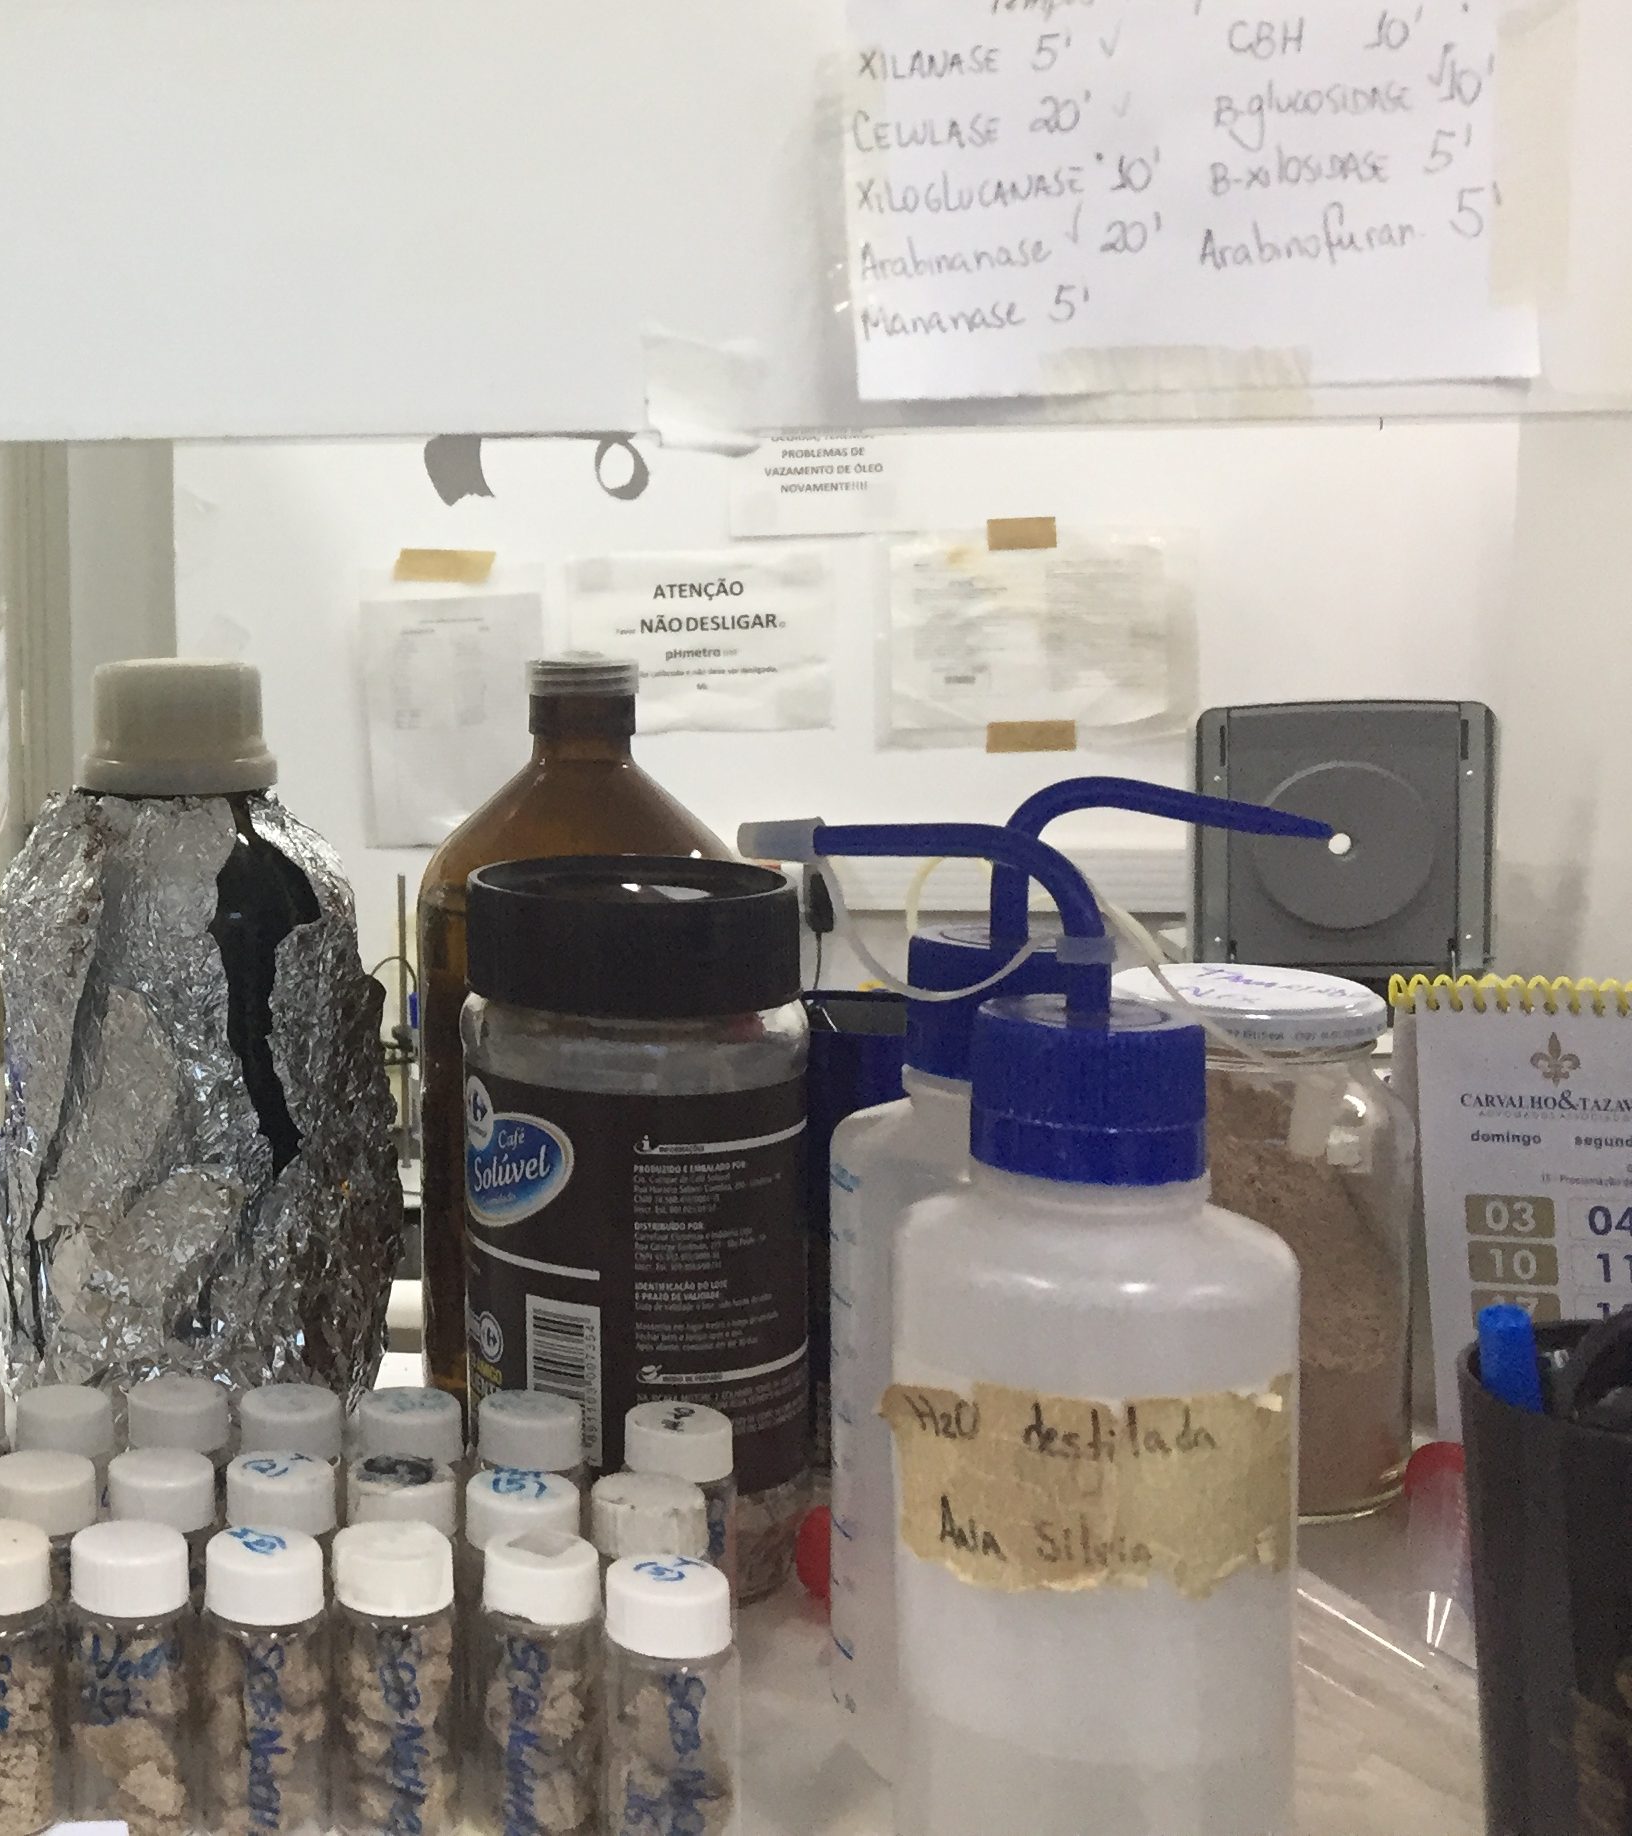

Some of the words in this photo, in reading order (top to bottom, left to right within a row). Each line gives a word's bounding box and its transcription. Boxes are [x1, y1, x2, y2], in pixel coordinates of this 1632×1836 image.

[781, 447, 848, 459] PROBLEMAS
[851, 447, 865, 456] DE
[764, 465, 834, 477] VAZAMENTO
[837, 465, 851, 474] DE
[854, 462, 883, 473] ÓLEO
[653, 578, 744, 601] ATENÇÃO
[640, 615, 683, 634] NÃO
[685, 613, 778, 632] DESLIGAR
[498, 1126, 525, 1150] Café
[1471, 1130, 1542, 1147] domingo
[473, 1145, 551, 1192] Solúvel
[1485, 1201, 1536, 1232] 03
[1489, 1248, 1537, 1280] 10
